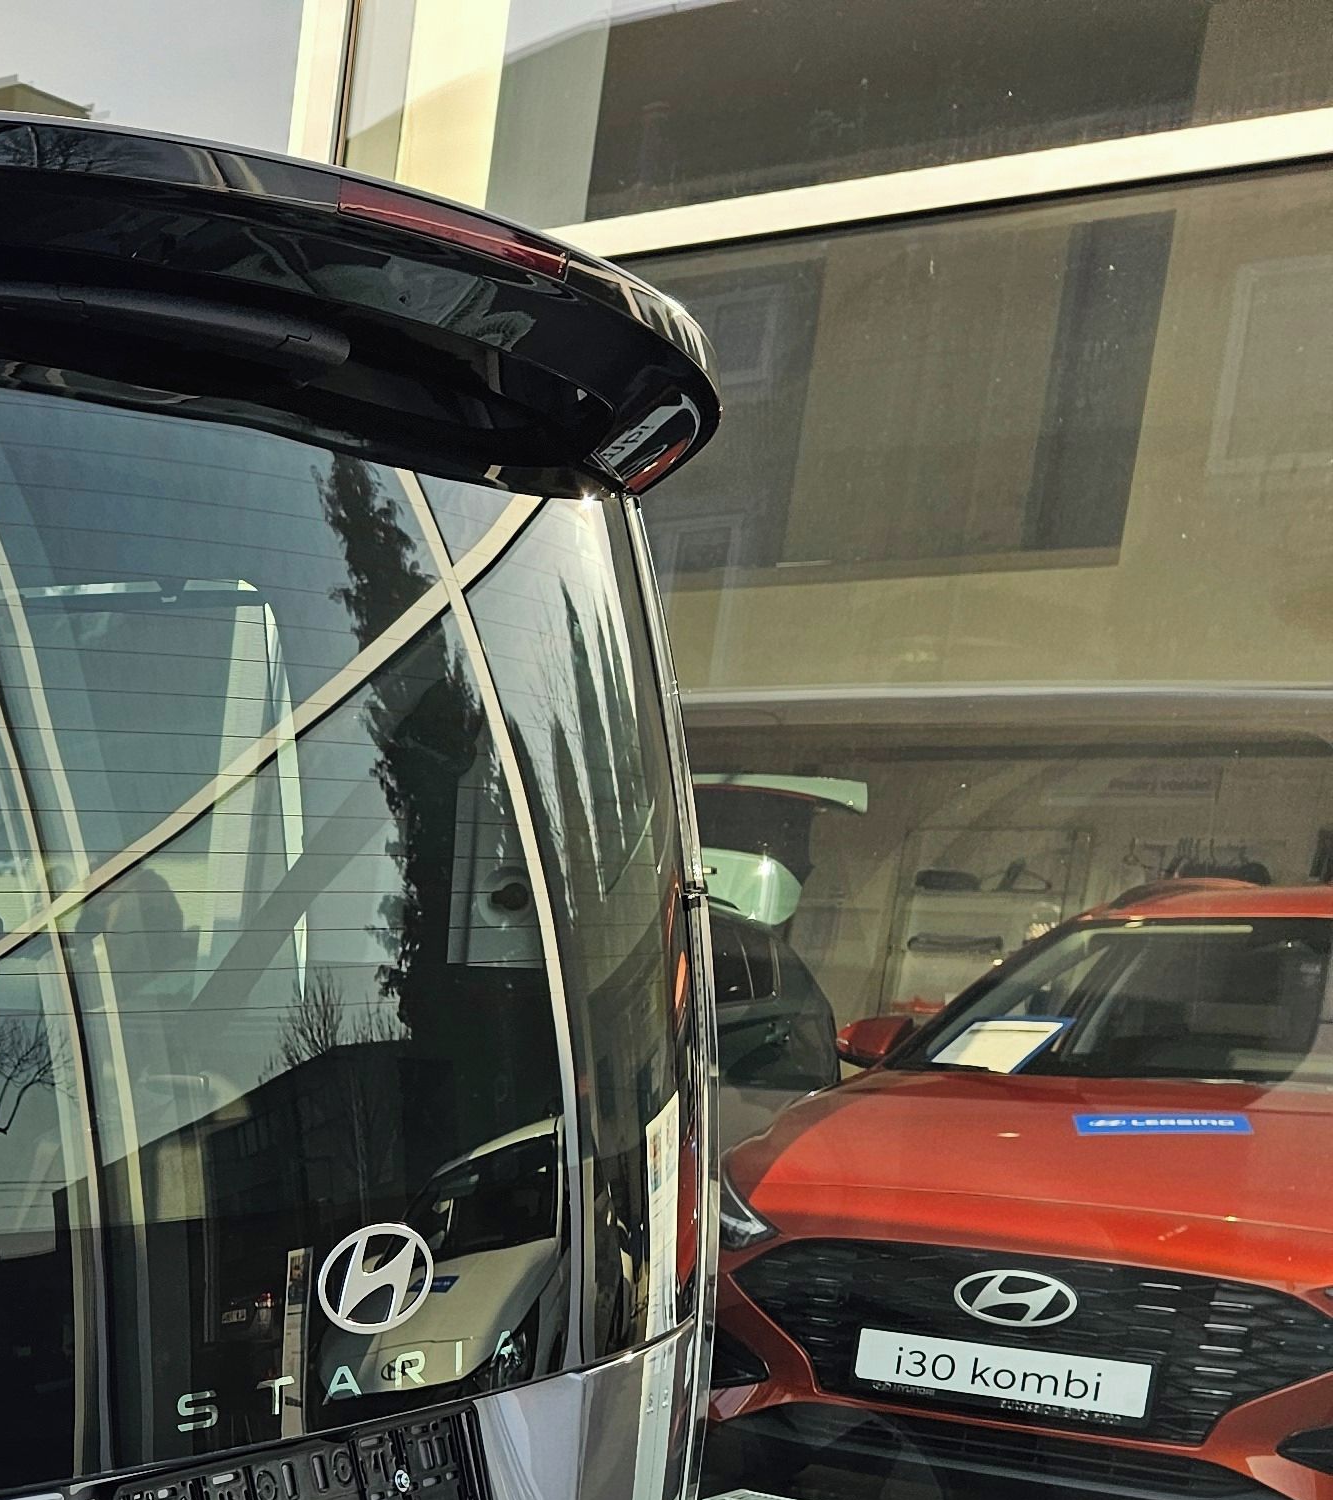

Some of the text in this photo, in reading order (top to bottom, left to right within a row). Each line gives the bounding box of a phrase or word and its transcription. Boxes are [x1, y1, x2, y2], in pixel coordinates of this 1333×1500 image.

[1131, 1119, 1235, 1127] LEASING
[176, 1330, 519, 1432] STARIA
[895, 1346, 1103, 1402] i30 kombi
